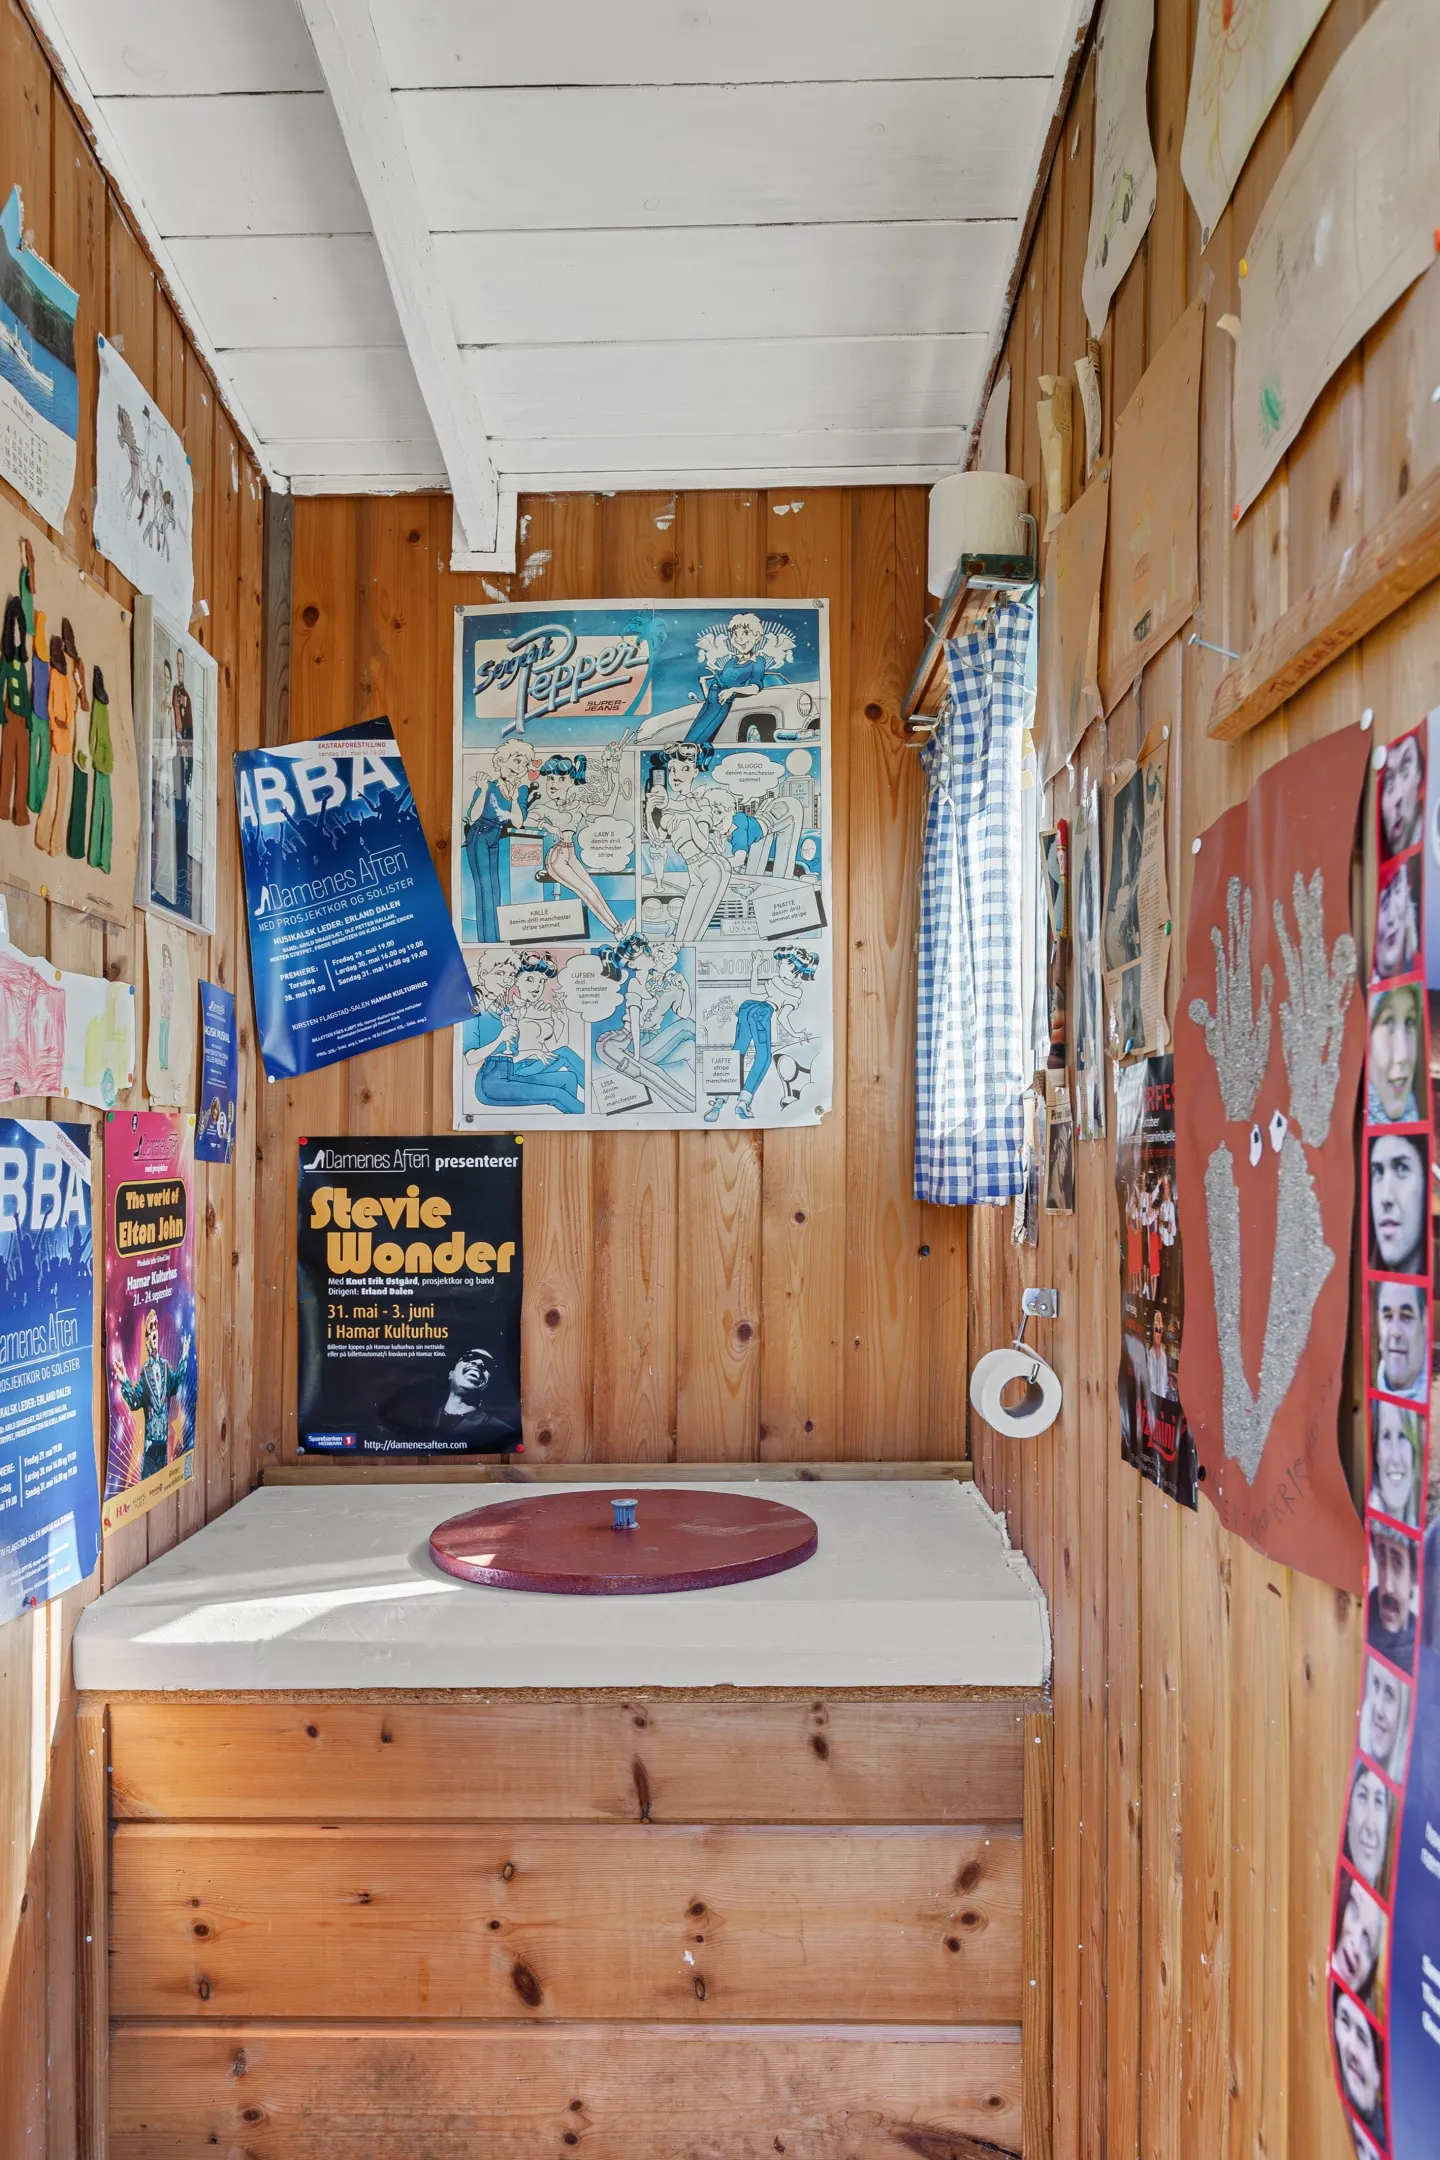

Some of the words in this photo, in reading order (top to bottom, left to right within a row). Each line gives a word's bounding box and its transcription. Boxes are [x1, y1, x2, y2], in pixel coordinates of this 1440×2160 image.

[506, 623, 650, 735] Pepper
[586, 699, 626, 707] SUPER-
[317, 741, 386, 750] EKSTRAFORESTILLING
[239, 756, 400, 830] ABBA
[268, 869, 357, 912] Damenes
[359, 844, 409, 887] Aften
[258, 919, 275, 933] MED
[276, 899, 348, 929] PROSJEKTKOR
[350, 893, 365, 906] OG
[367, 877, 415, 901] SOLISTER
[771, 908, 789, 917] denim
[773, 899, 796, 910] FNATTE
[272, 925, 317, 945] MUSIKALSK
[317, 919, 344, 935] LEDER:
[344, 909, 375, 925] ERLAND
[376, 899, 401, 915] DALEN
[539, 914, 571, 922] manchester
[769, 915, 791, 925] sammet
[791, 911, 807, 919] stripe
[331, 955, 354, 967] Fredag
[354, 949, 365, 960] 29.
[365, 945, 378, 956] mai
[377, 940, 395, 950] 19.00
[334, 963, 357, 976] Lørdag
[357, 959, 368, 968] 30.
[368, 956, 381, 966] mai
[380, 949, 398, 960] 16.00
[398, 946, 407, 955] og
[406, 940, 424, 951] 19.00
[279, 965, 319, 982] PREMIERE:
[337, 972, 362, 986] Søndag
[362, 969, 372, 978] 31.
[371, 966, 385, 974] mai
[384, 958, 402, 971] 16.00
[401, 956, 410, 964] og
[410, 949, 428, 961] 19.00
[284, 994, 296, 1002] 28.
[295, 989, 308, 1000] mai
[308, 984, 326, 995] 19.00
[288, 978, 316, 990] Torsdag
[291, 1017, 319, 1031] KIRSTEN
[319, 1000, 370, 1023] FLAGSTAD-SALEN
[370, 993, 393, 1006] HAMAR
[392, 980, 429, 998] KULTURHUS
[600, 1079, 615, 1088] LISA
[602, 1086, 620, 1095] denim
[606, 1093, 638, 1107] manchester
[325, 1149, 391, 1169] Damenes
[393, 1148, 430, 1173] Aften
[434, 1155, 519, 1172] presenterer
[125, 1191, 145, 1211] The
[146, 1188, 171, 1208] world
[170, 1187, 180, 1205] of
[310, 1184, 452, 1230] Stevie
[118, 1220, 157, 1249] Elton
[157, 1215, 184, 1242] John
[327, 1231, 516, 1275] Wonder
[126, 1275, 151, 1292] Hamar
[151, 1267, 178, 1285] Kulturhus
[328, 1277, 344, 1286] Med
[345, 1277, 367, 1286] Knut
[367, 1277, 385, 1285] Erik
[385, 1276, 420, 1287] Østgård,
[421, 1276, 463, 1287] prosjektkor
[464, 1278, 474, 1287] og
[475, 1276, 495, 1285] band
[328, 1287, 360, 1297] Dirigent:
[361, 1287, 388, 1295] Erland
[389, 1288, 414, 1296] Dalen
[327, 1304, 349, 1319] 31.
[353, 1303, 378, 1319] mai
[392, 1304, 405, 1319] 3.
[408, 1303, 434, 1322] juni
[48, 1307, 78, 1357] Aften
[327, 1323, 332, 1339] i
[336, 1324, 381, 1339] Hamar
[384, 1322, 449, 1339] Kulturhus
[339, 1351, 347, 1359] på
[408, 1351, 416, 1359] på
[41, 1366, 51, 1380] OG
[51, 1357, 81, 1377] SOLISTER
[308, 1435, 343, 1443] Sparebanken
[363, 1439, 468, 1451] http://damenesaften.com
